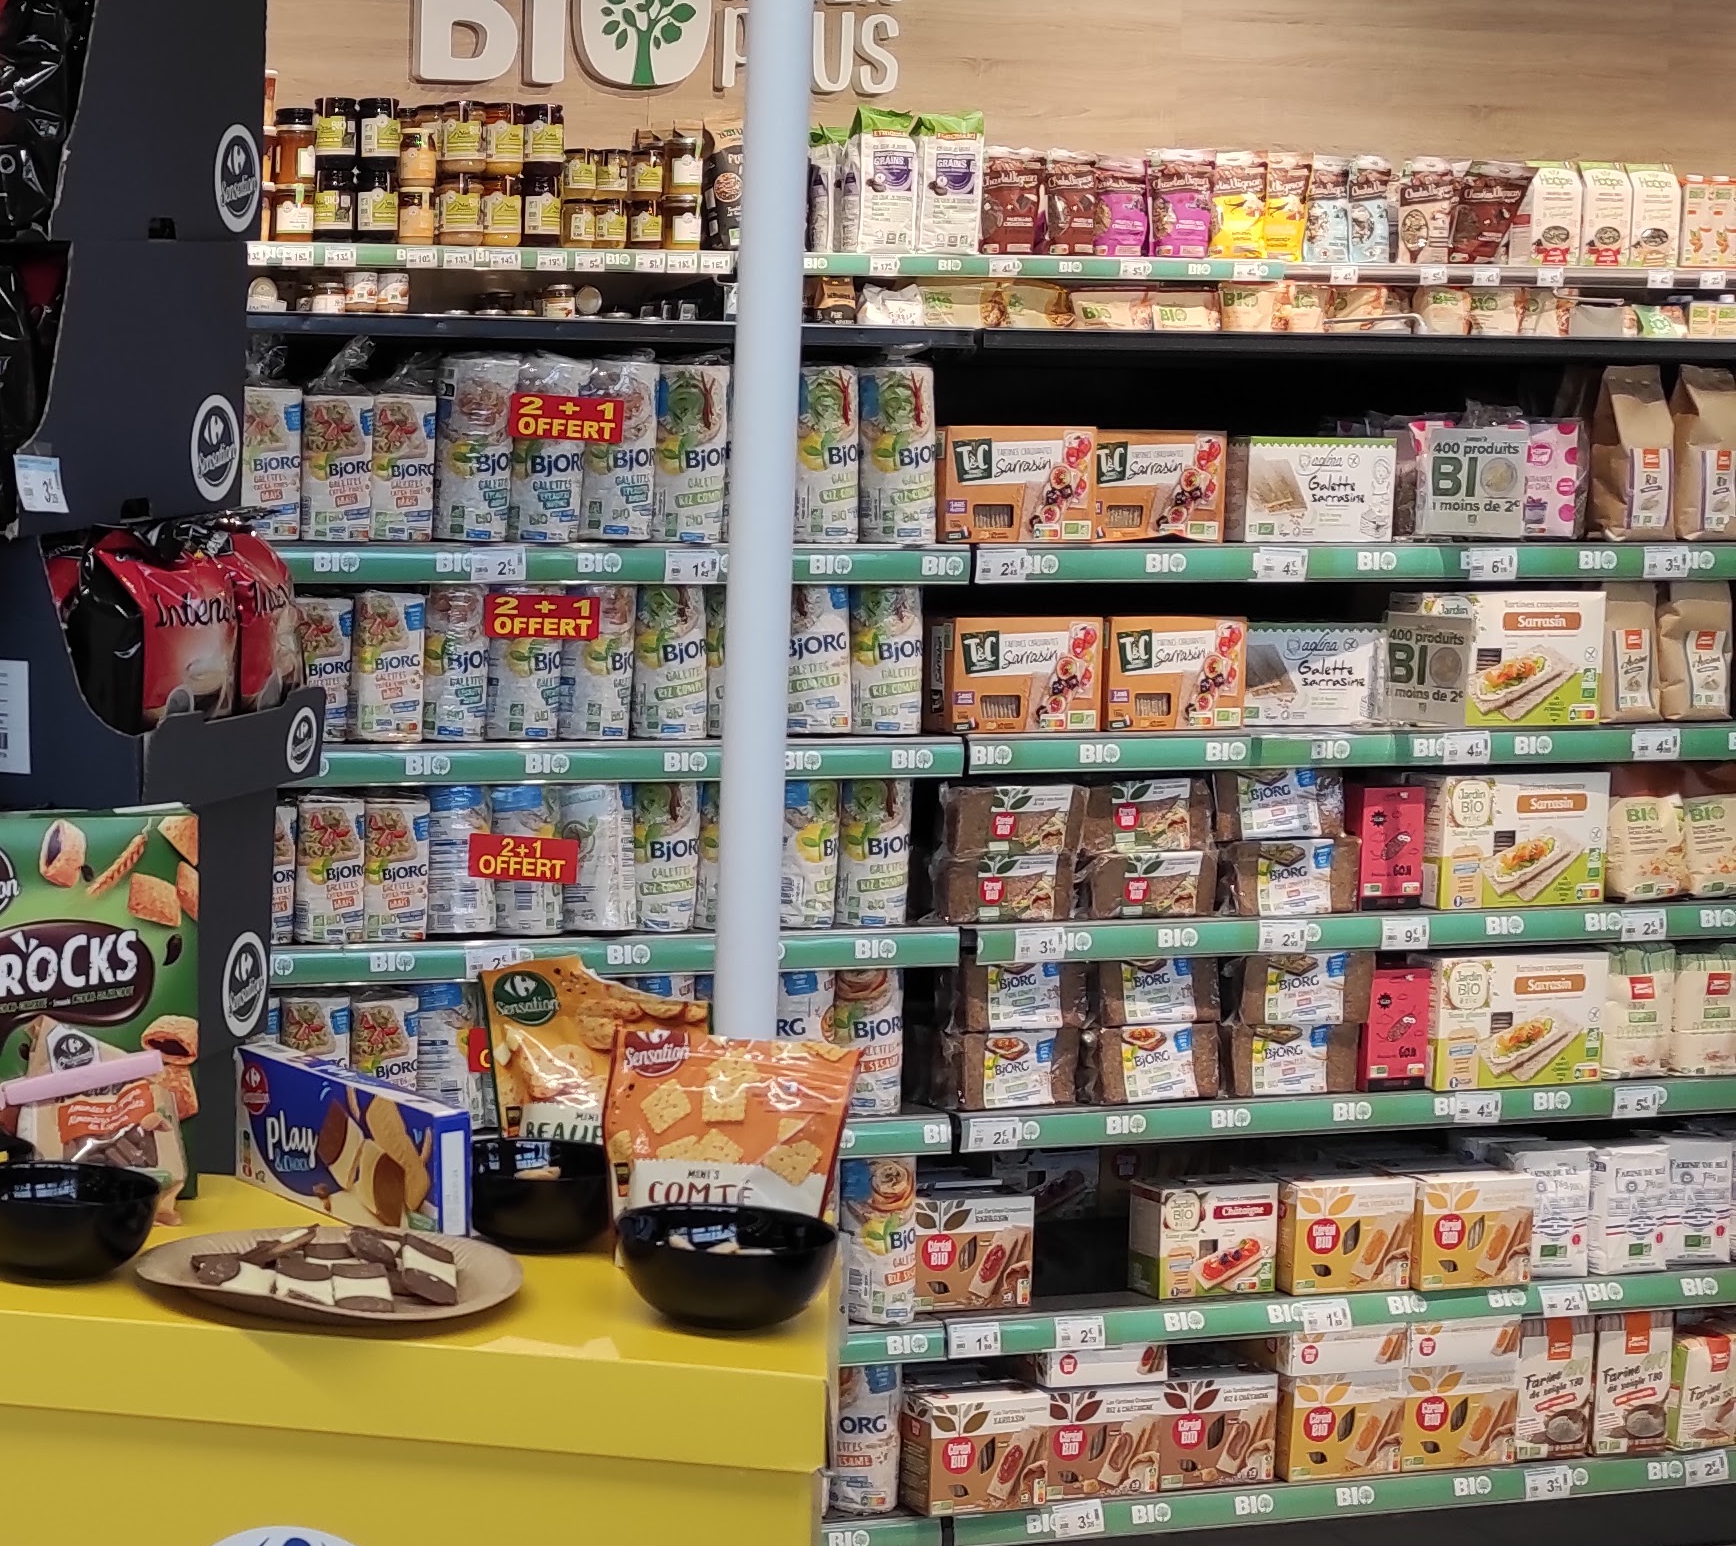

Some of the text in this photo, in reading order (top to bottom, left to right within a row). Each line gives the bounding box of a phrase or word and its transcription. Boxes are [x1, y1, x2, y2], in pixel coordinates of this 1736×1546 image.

[517, 397, 543, 416] 2
[517, 417, 617, 440] OFFERT
[1463, 442, 1520, 457] produits
[994, 455, 1052, 479] Sarrasin
[1439, 500, 1484, 513] moins
[1487, 500, 1504, 513] de
[478, 854, 566, 881] OFFERT
[624, 1044, 690, 1070] Sensation
[647, 1176, 756, 1205] COMTÉ
